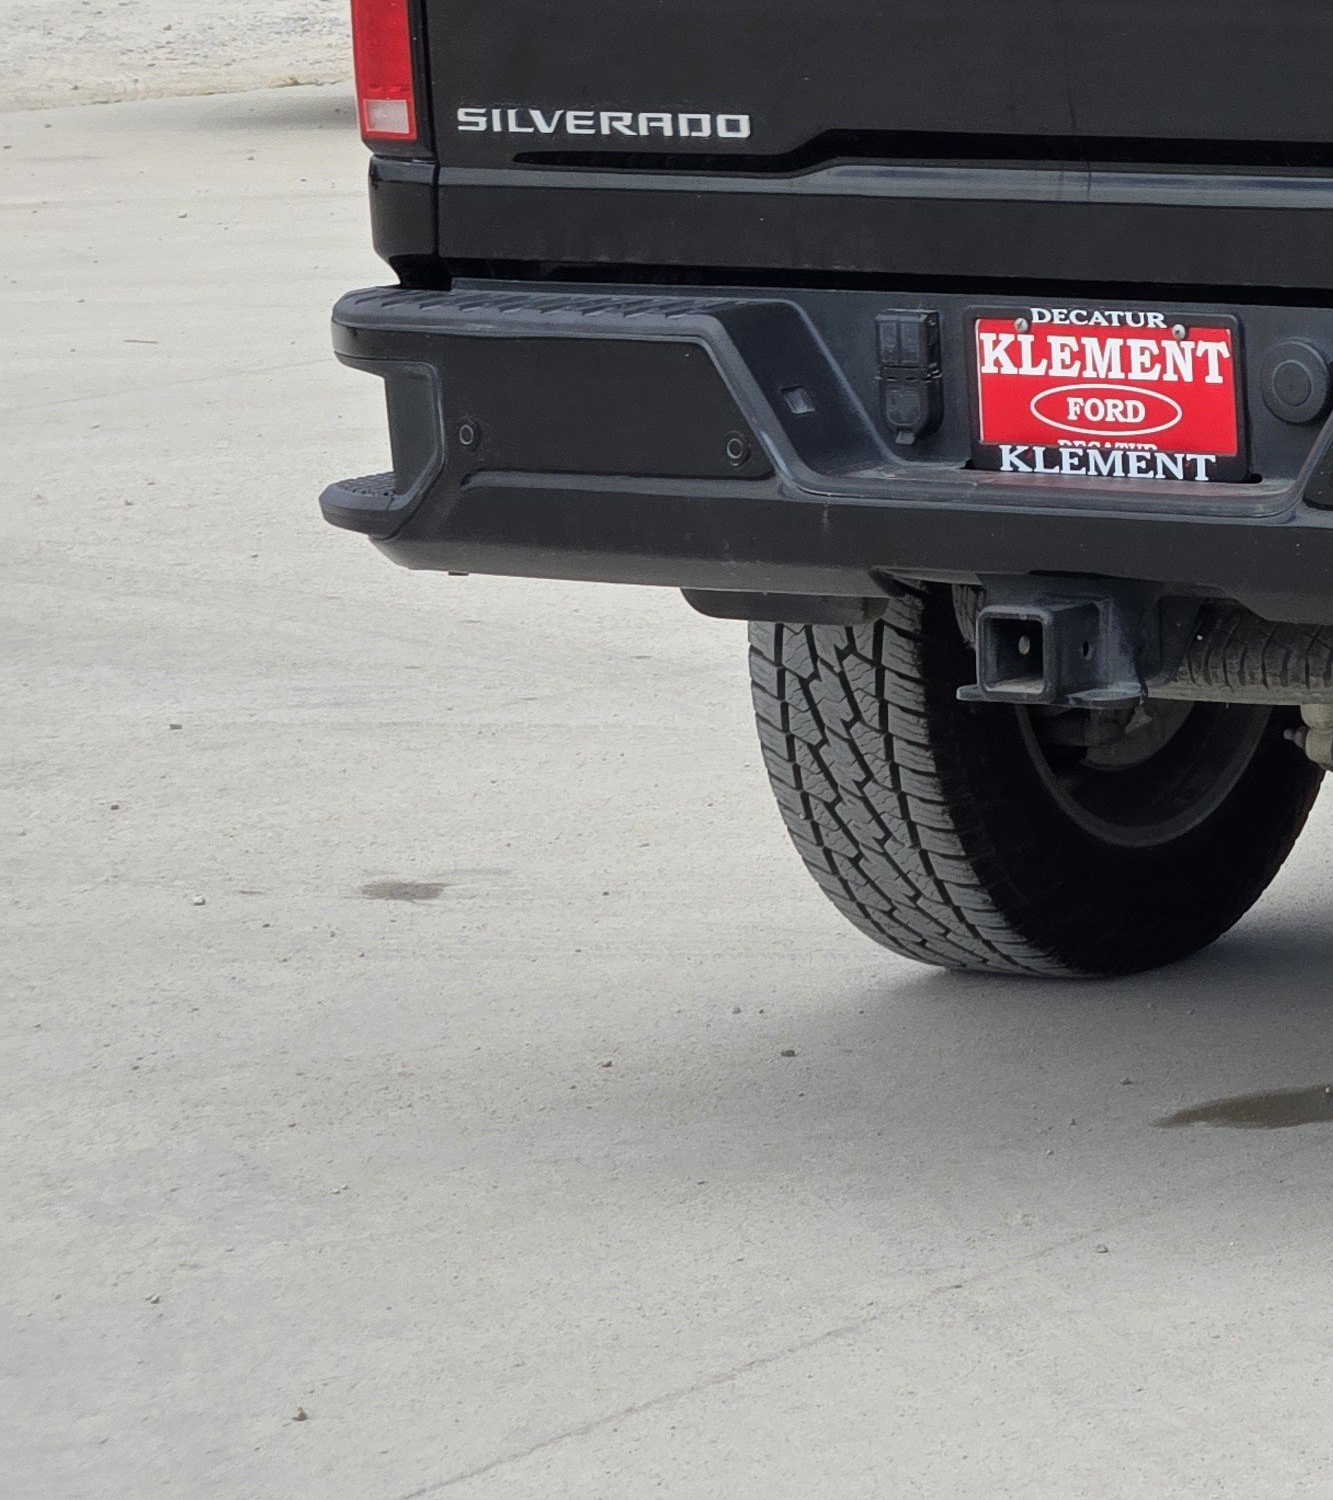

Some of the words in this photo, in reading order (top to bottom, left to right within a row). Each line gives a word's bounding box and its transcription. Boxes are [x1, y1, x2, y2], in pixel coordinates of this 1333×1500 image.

[457, 107, 751, 138] SILVERADO
[1030, 307, 1167, 329] DECATUR
[979, 332, 1230, 384] KLEMENT
[1066, 397, 1146, 423] FORD
[999, 444, 1216, 481] KLEMENT
